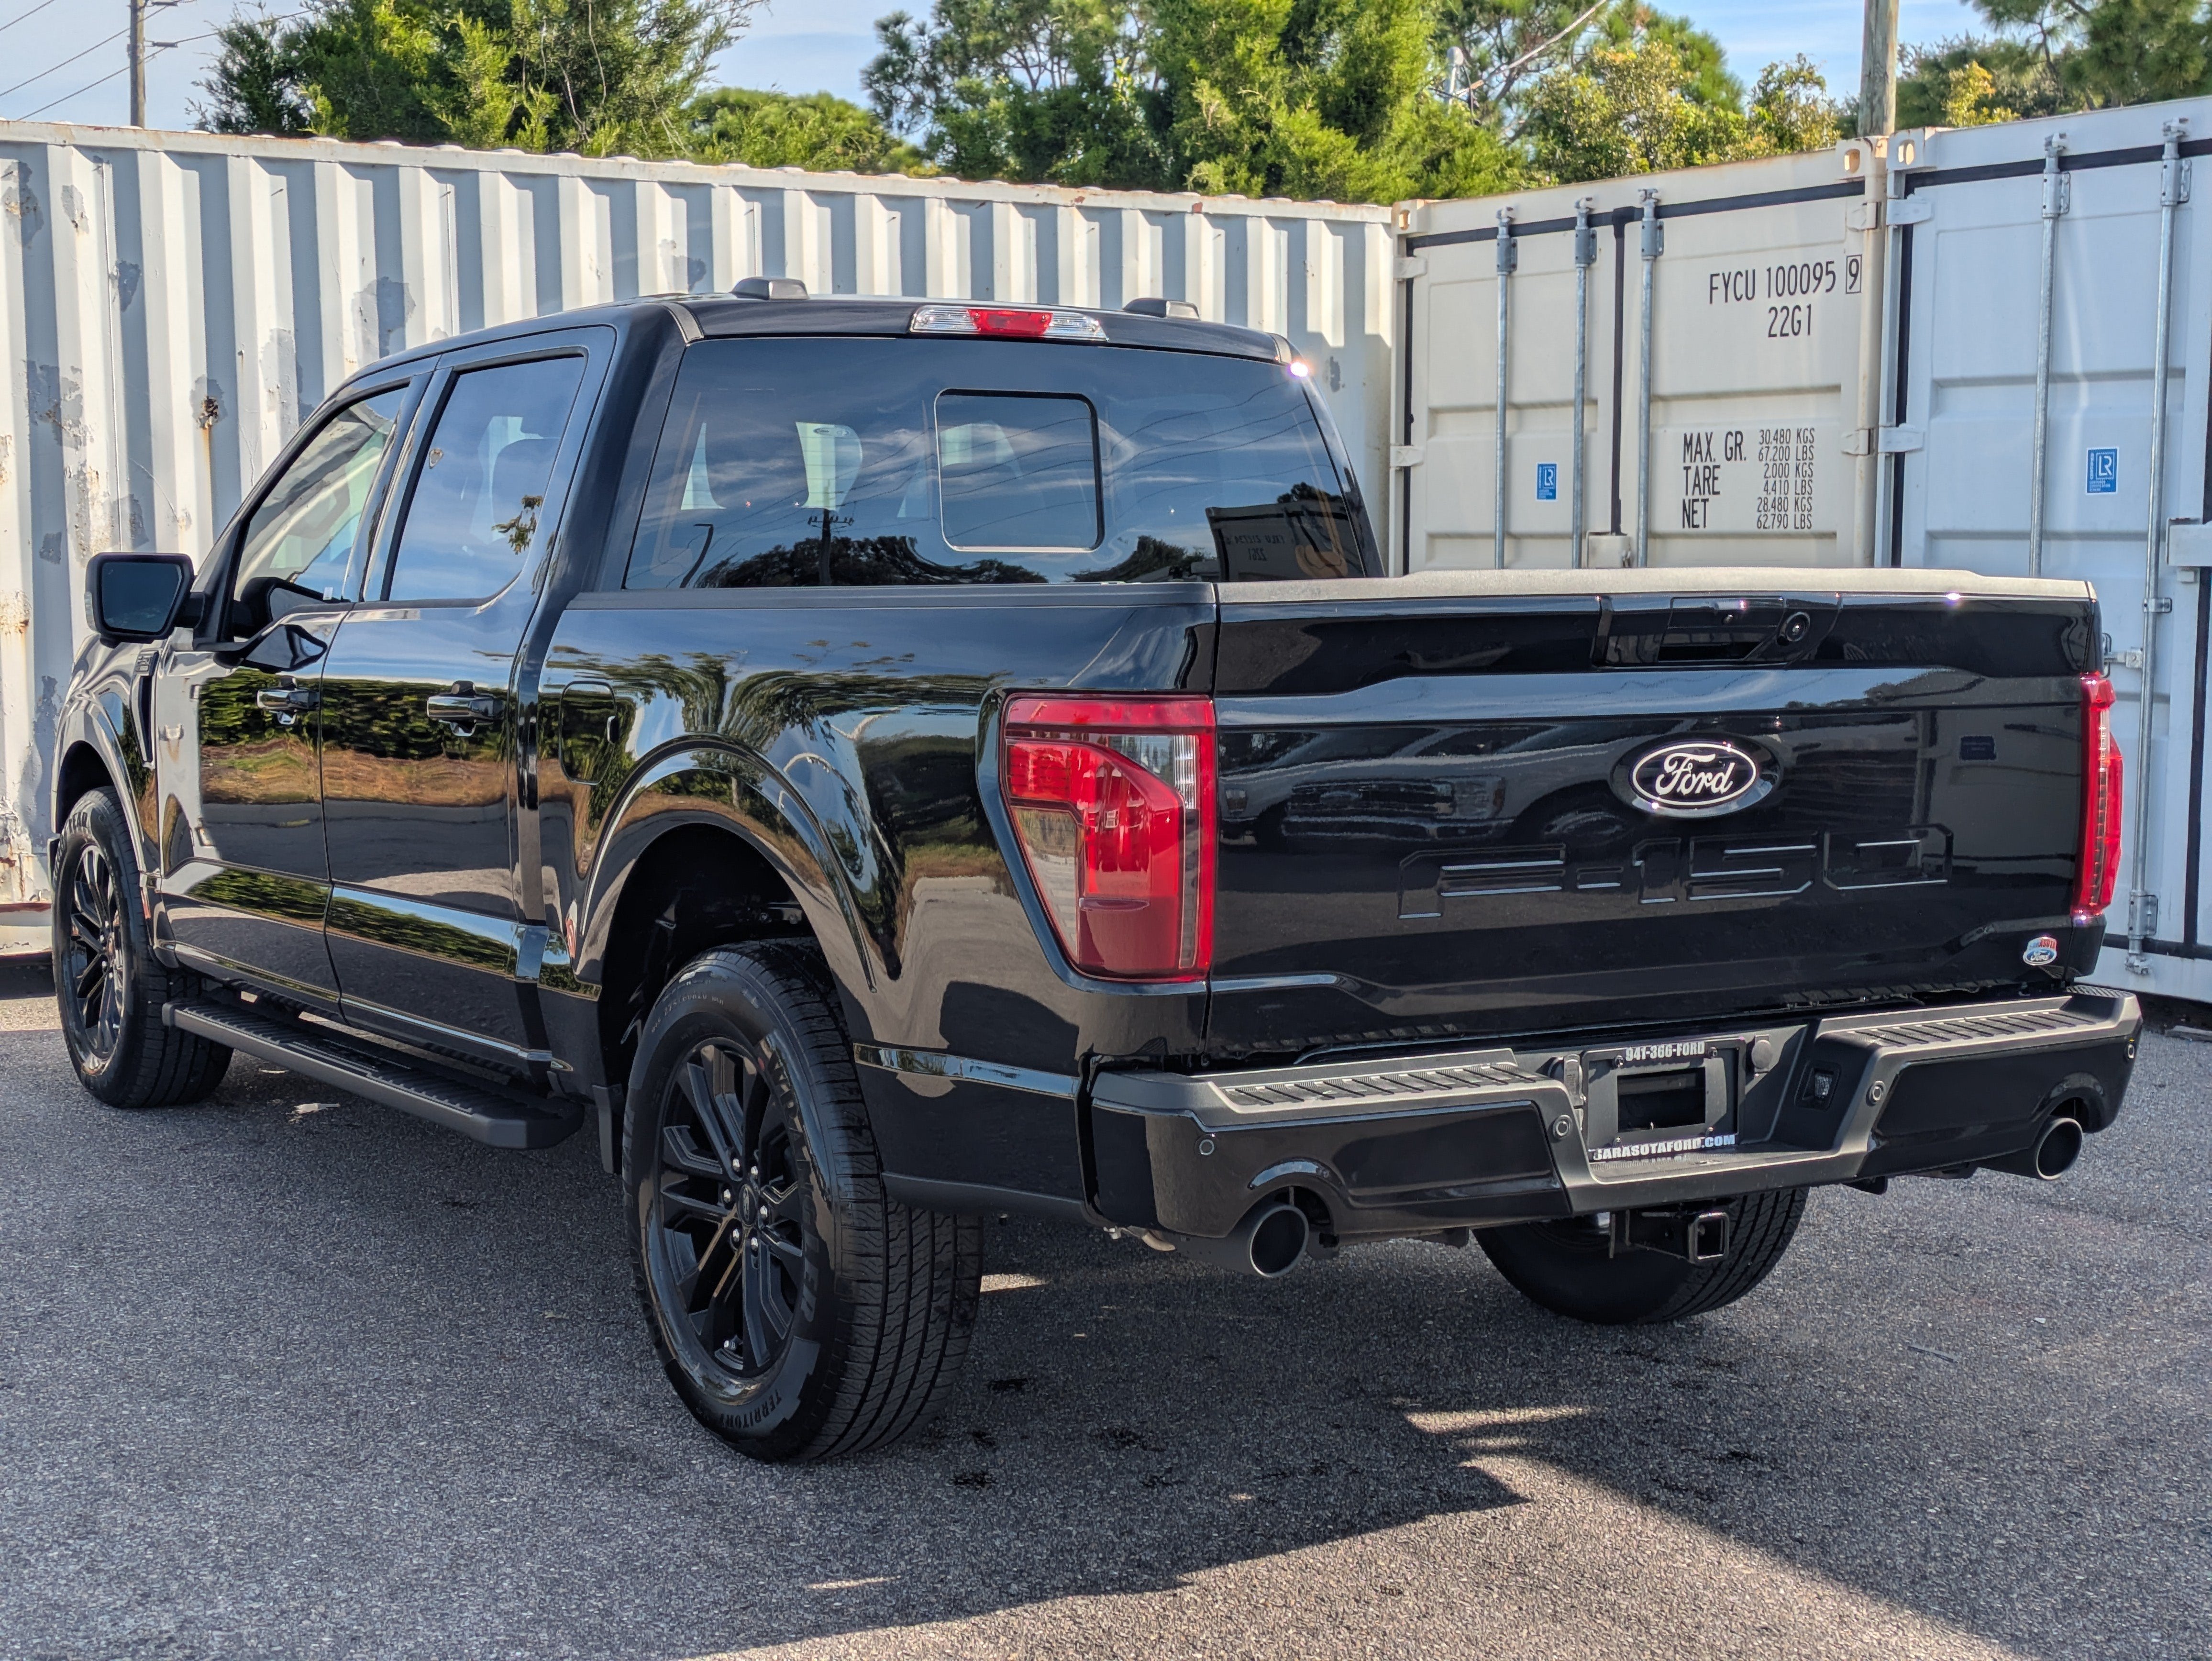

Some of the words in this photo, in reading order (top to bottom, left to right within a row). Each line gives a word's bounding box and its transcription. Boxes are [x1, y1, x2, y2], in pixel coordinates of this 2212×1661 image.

[1709, 269, 1756, 304] FYCU
[1766, 261, 1836, 298] 100095
[1848, 258, 1859, 290] 9
[1768, 304, 1812, 337] 22G1
[1683, 432, 1716, 463] MAX.
[1725, 431, 1747, 462] GR.
[1759, 429, 1791, 445] 30.480
[1796, 428, 1815, 444] KGS
[1758, 445, 1790, 462] 67.200
[1796, 445, 1814, 461] LBS
[1545, 469, 1553, 486] LR
[1683, 465, 1721, 496] TARE
[1764, 463, 1790, 478] 2.000
[1795, 462, 1814, 478] KGS
[2099, 455, 2112, 476] LR
[1763, 479, 1789, 495] 4.410
[1795, 479, 1813, 495] LBS
[1682, 498, 1709, 529] NET
[1757, 497, 1789, 512] 28.480
[1794, 496, 1812, 512] KGS
[1757, 513, 1788, 529] 62.790
[1794, 513, 1812, 529] LBS
[1655, 753, 1736, 795] Ford
[1398, 824, 1954, 919] F-150
[2030, 950, 2051, 961] Ford
[1626, 1041, 1705, 1061] 941-366-FORD
[1593, 1134, 1735, 1161] SARASOTAFORD.COM
